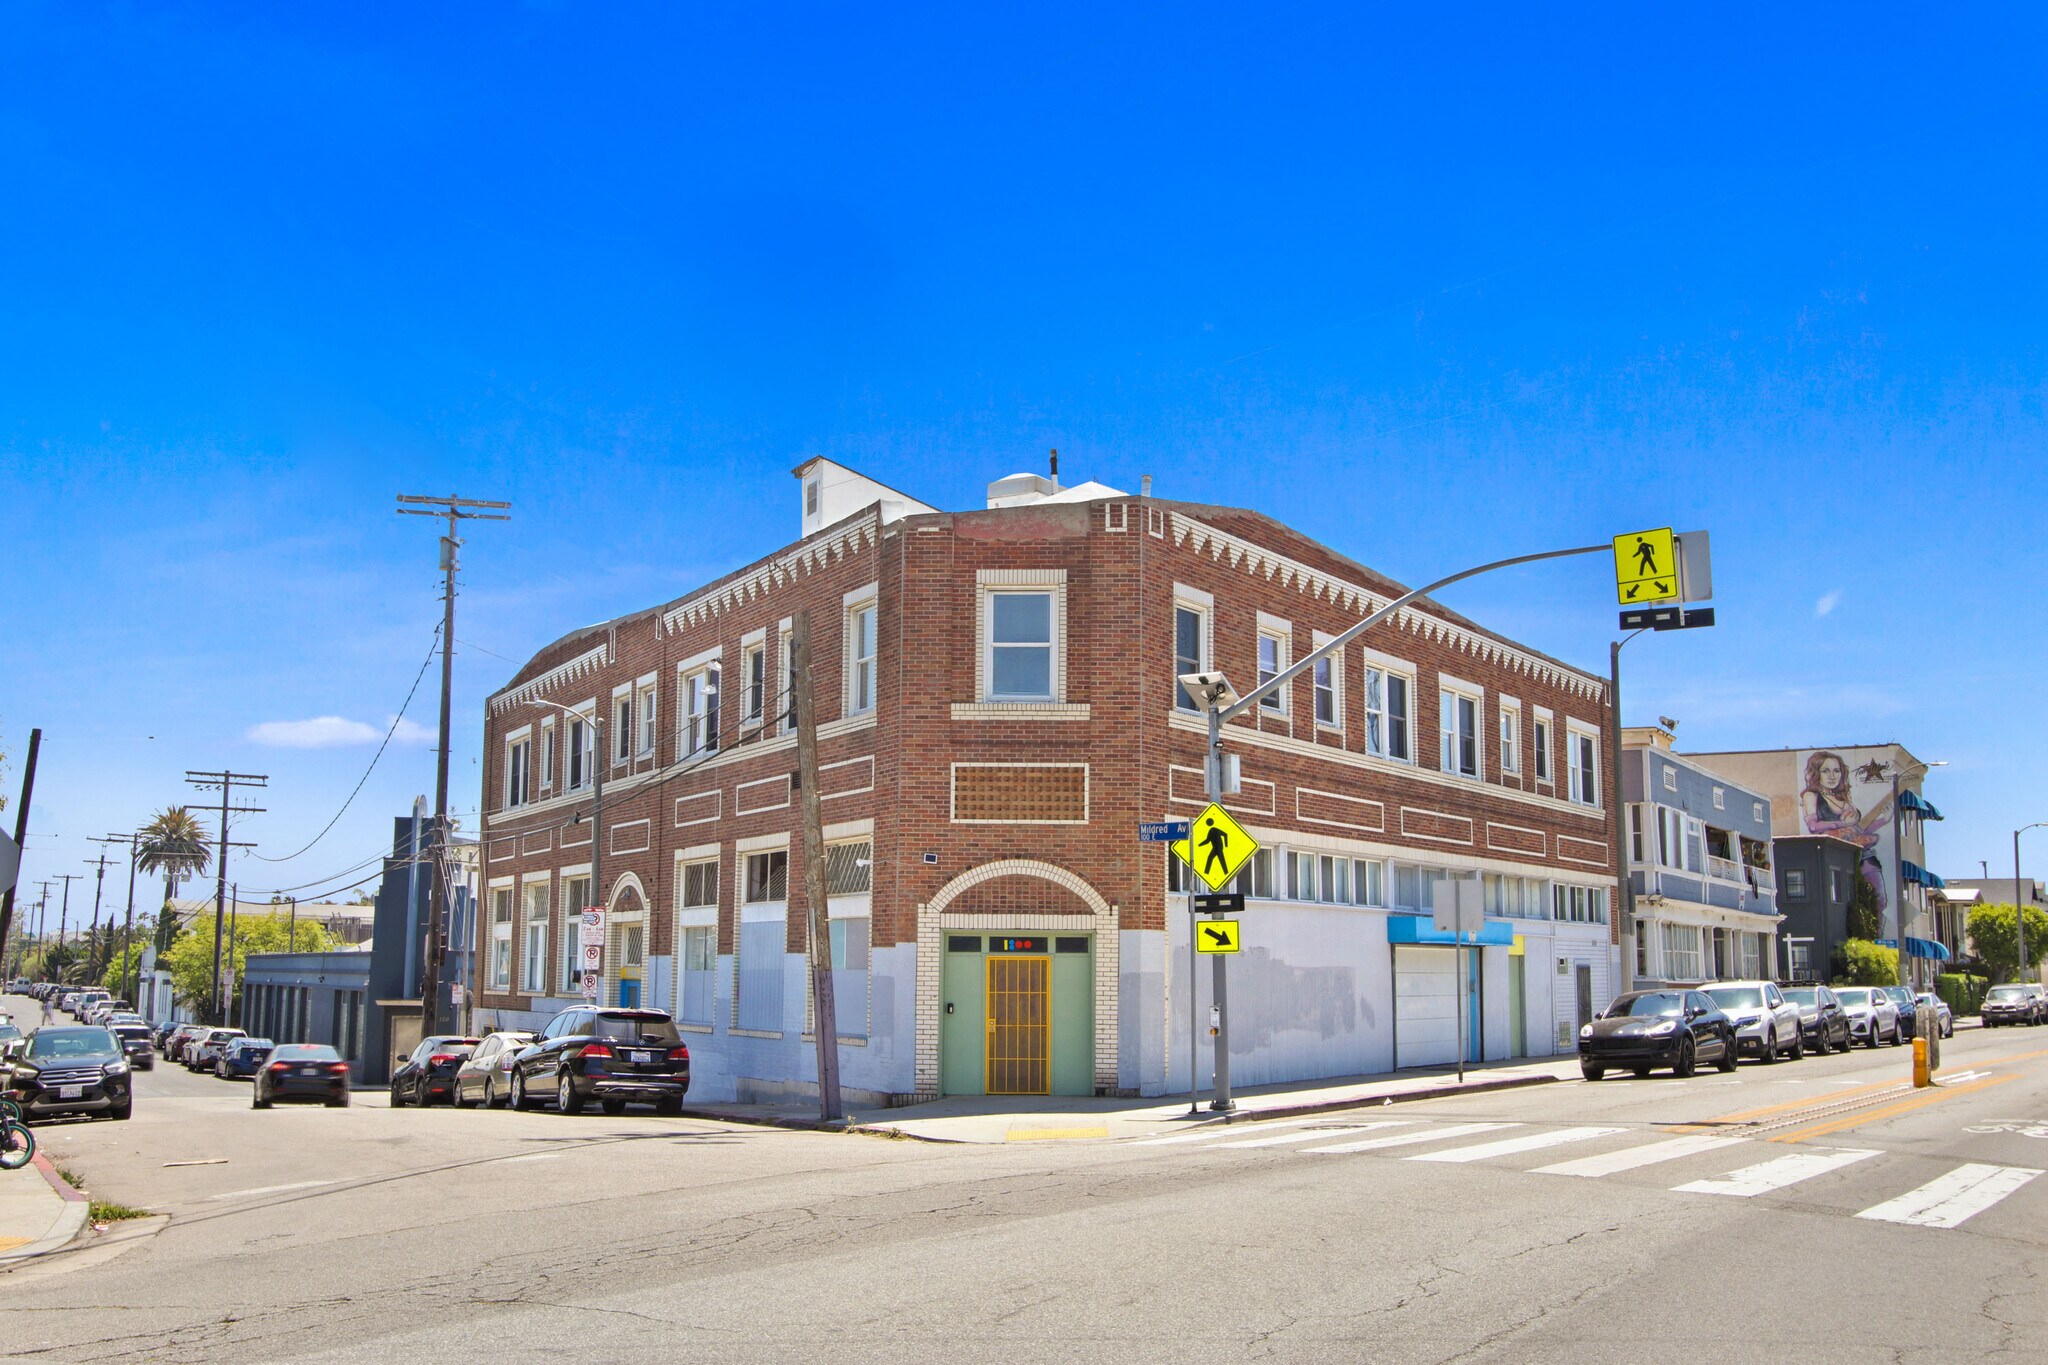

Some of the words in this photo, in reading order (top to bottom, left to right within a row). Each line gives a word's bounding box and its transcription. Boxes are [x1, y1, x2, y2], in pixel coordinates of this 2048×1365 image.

[1140, 824, 1168, 834] Mildred
[1177, 823, 1187, 833] Av
[1003, 939, 1032, 951] 1800
